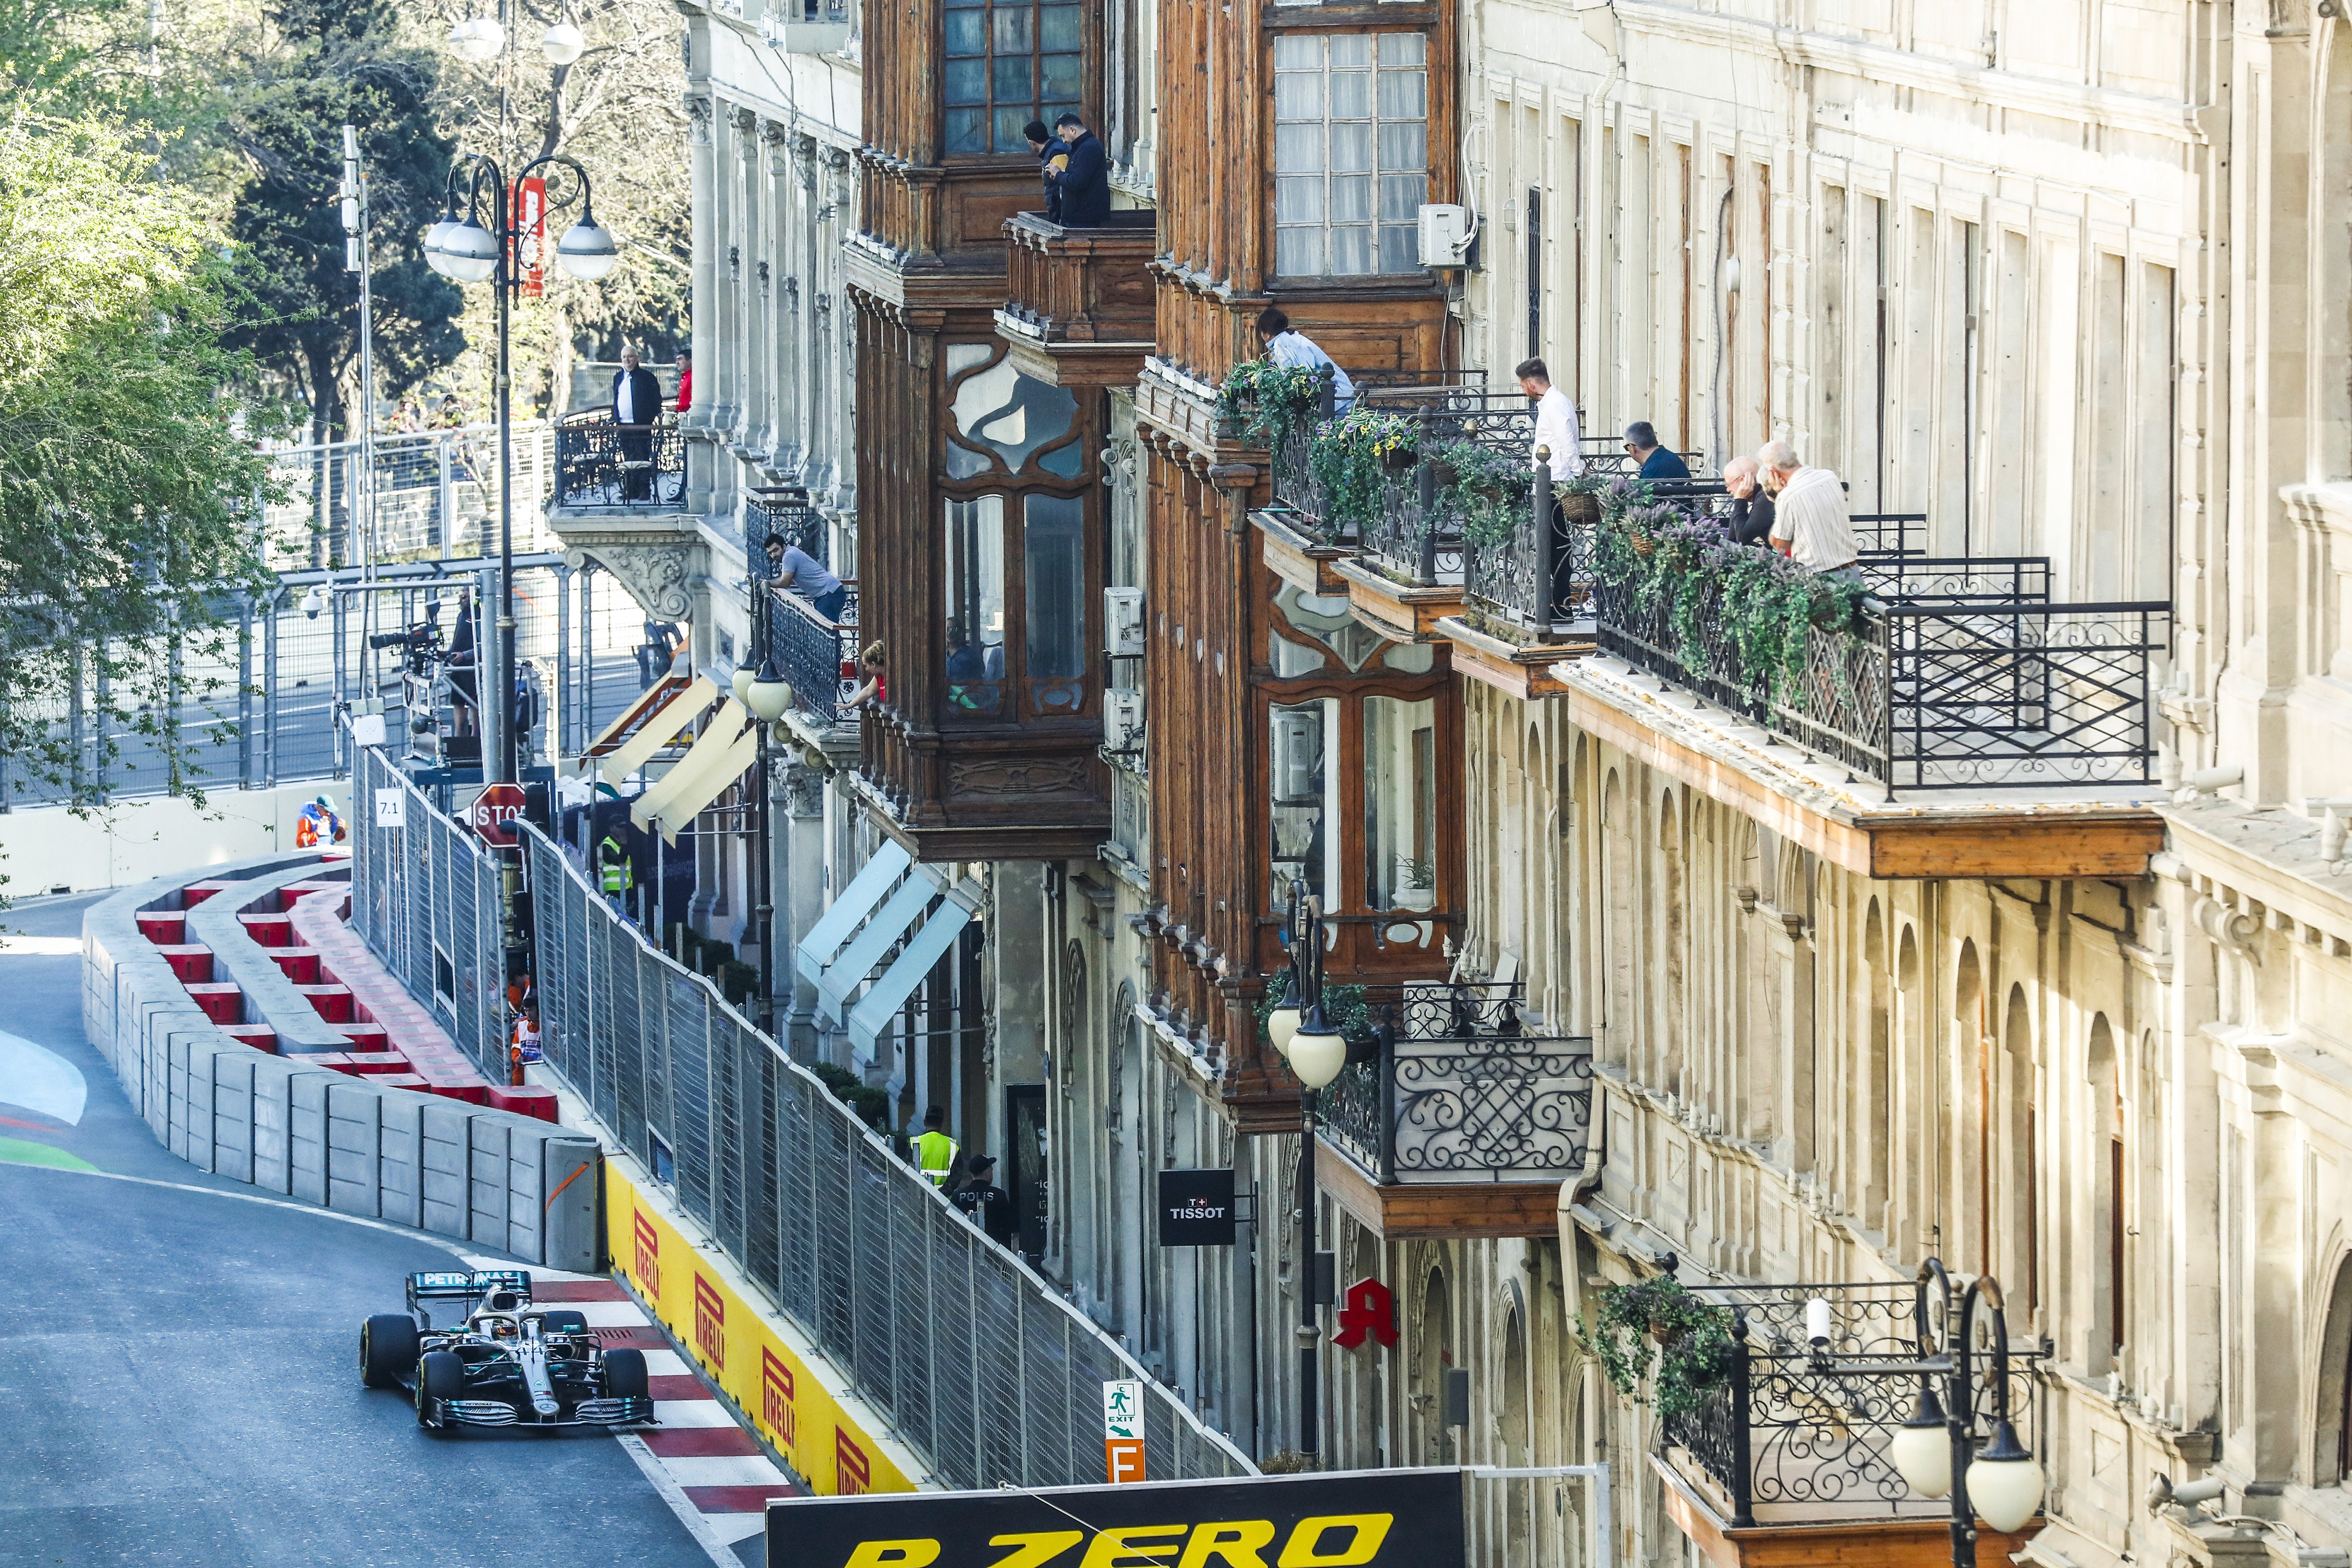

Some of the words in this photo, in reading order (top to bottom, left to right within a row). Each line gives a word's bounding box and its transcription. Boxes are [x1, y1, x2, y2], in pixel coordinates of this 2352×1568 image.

[380, 802, 398, 814] 7.1
[477, 805, 526, 826] STO
[1170, 1207, 1225, 1219] TISSOT
[634, 1206, 660, 1301] PIRELLI
[695, 1271, 724, 1372] PIRELLI
[762, 1344, 795, 1449] PIRELLI
[1112, 1447, 1137, 1483] F
[988, 1513, 1394, 1568] ZERO
